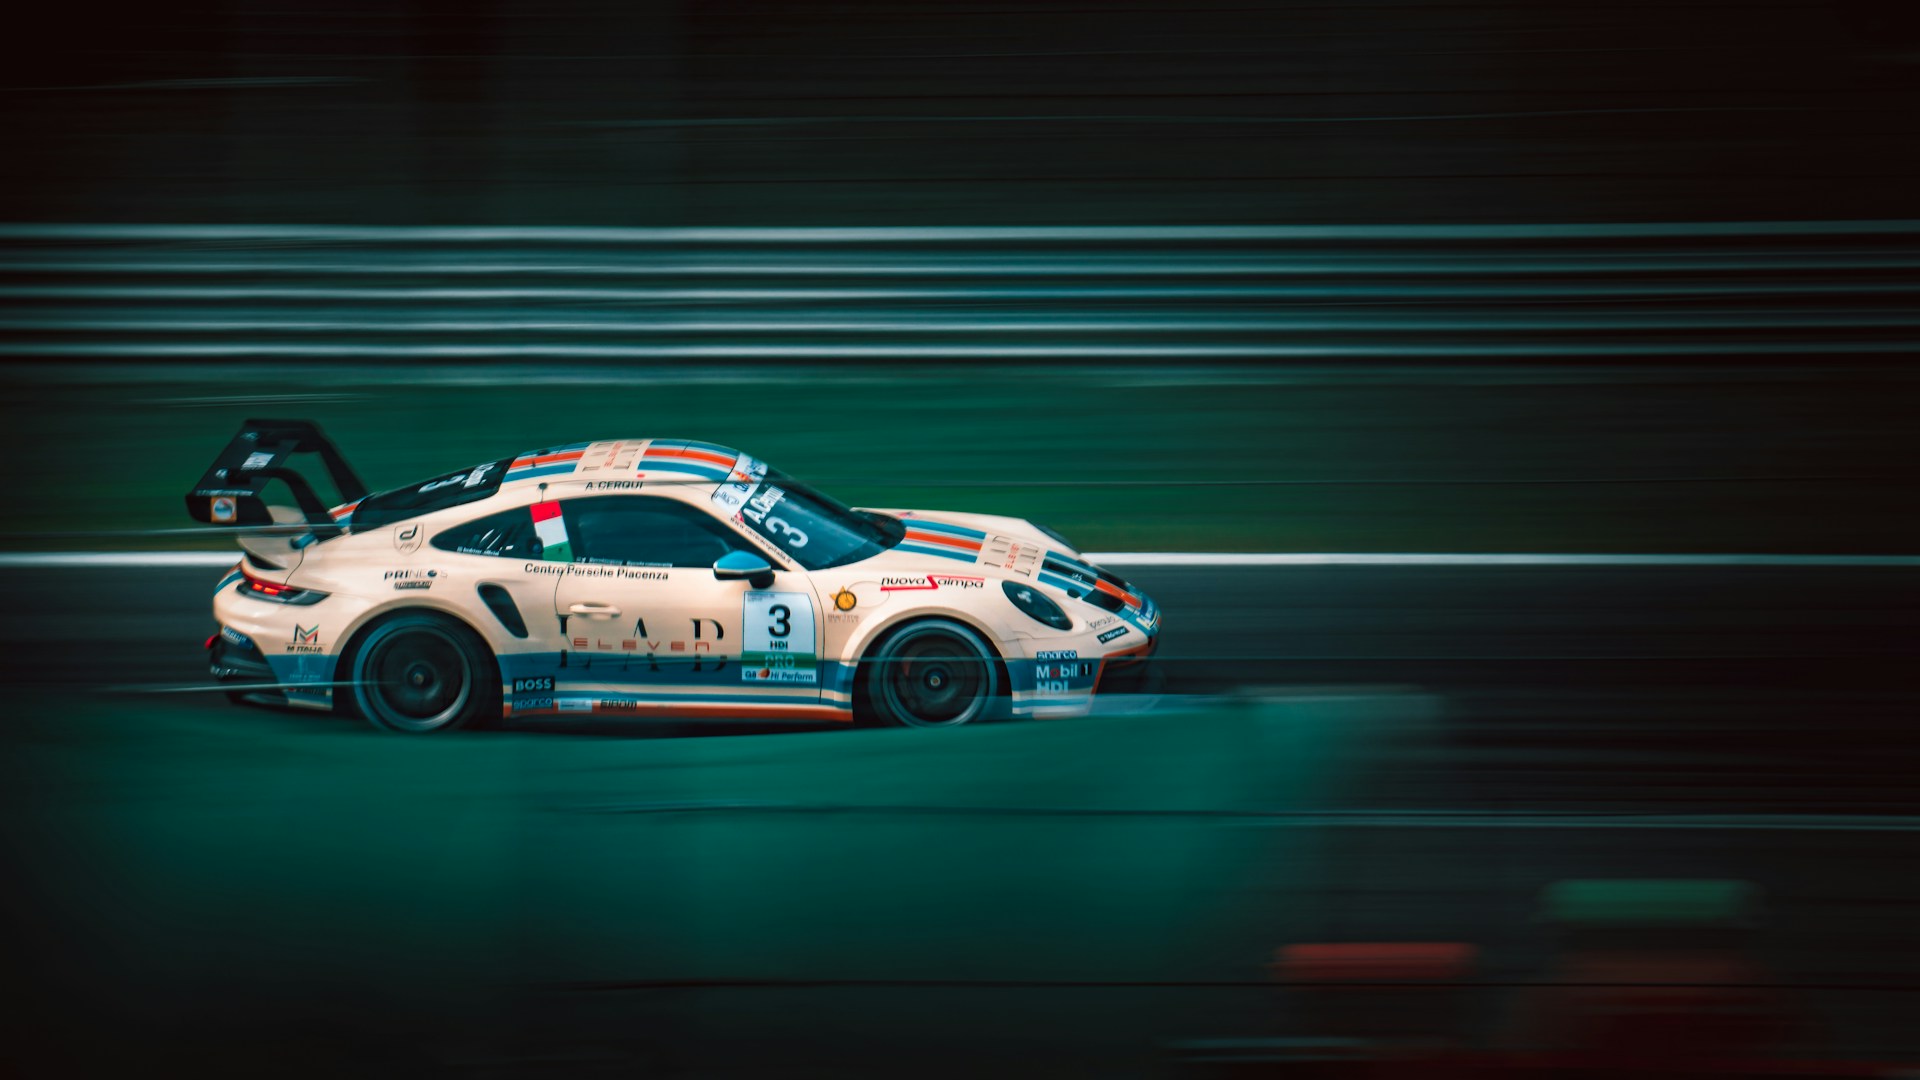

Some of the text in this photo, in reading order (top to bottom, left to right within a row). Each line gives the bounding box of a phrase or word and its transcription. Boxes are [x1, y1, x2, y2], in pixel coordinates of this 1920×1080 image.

[765, 516, 809, 548] 3
[524, 562, 564, 576] Centro
[567, 564, 614, 578] Porsche
[616, 568, 669, 581] Piacenza
[881, 576, 926, 587] nuova
[768, 604, 791, 638] 3
[573, 637, 710, 652] ELEVEN
[770, 640, 788, 650] HDI
[765, 654, 795, 668] PRO
[782, 671, 814, 682] Perform
[1036, 662, 1078, 679] Mobil
[515, 678, 552, 691] BOSS
[1036, 681, 1069, 694] HDI
